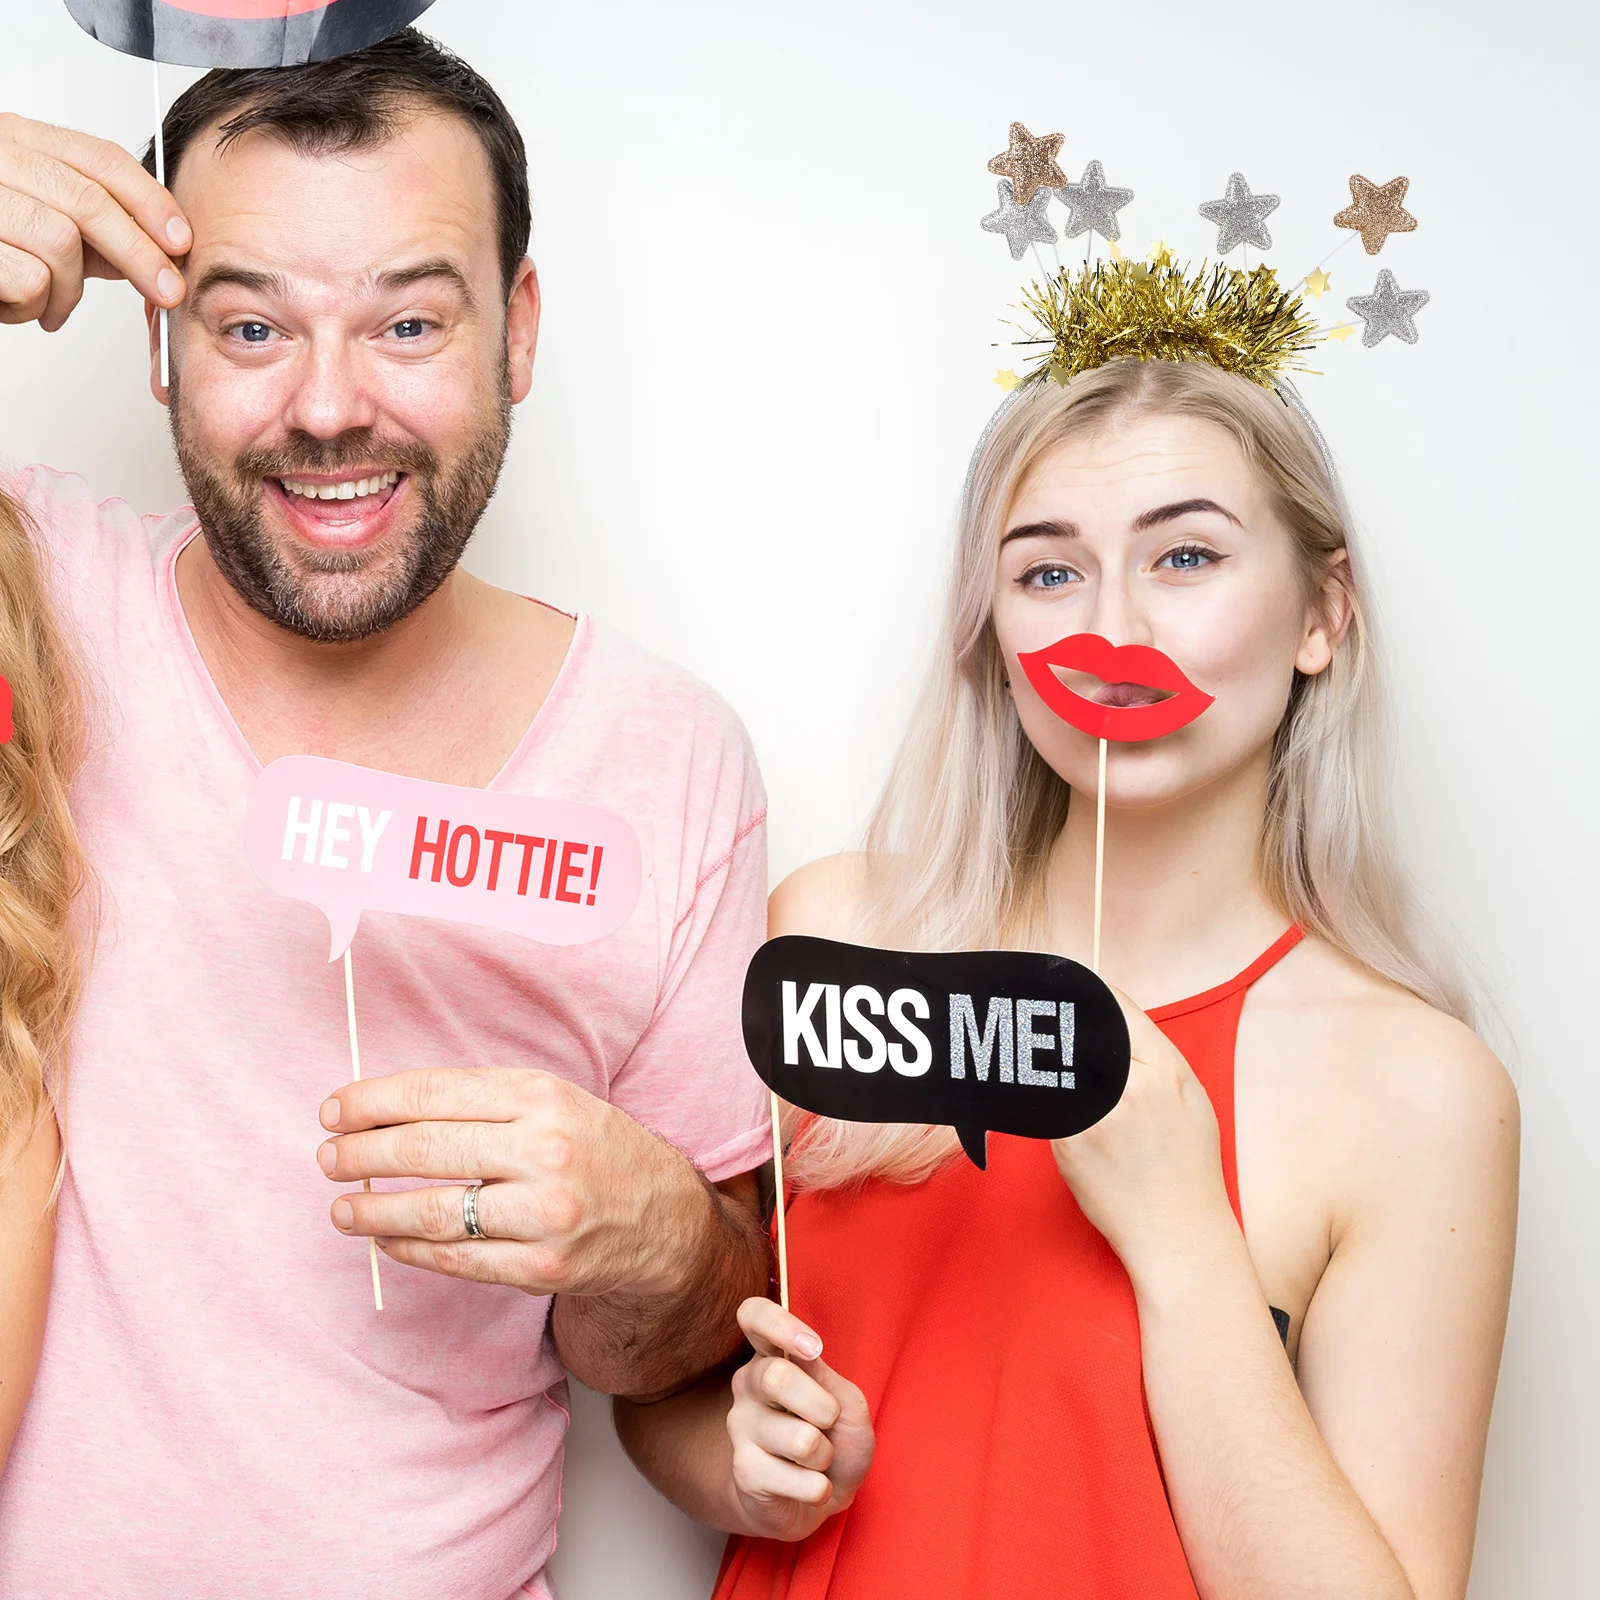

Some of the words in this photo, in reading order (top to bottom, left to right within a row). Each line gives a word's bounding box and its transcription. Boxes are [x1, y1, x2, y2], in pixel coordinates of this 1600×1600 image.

[281, 796, 393, 873] HEY
[408, 816, 604, 907] HOTTIE!
[781, 980, 933, 1078] KISS
[948, 993, 1077, 1090] ME!
